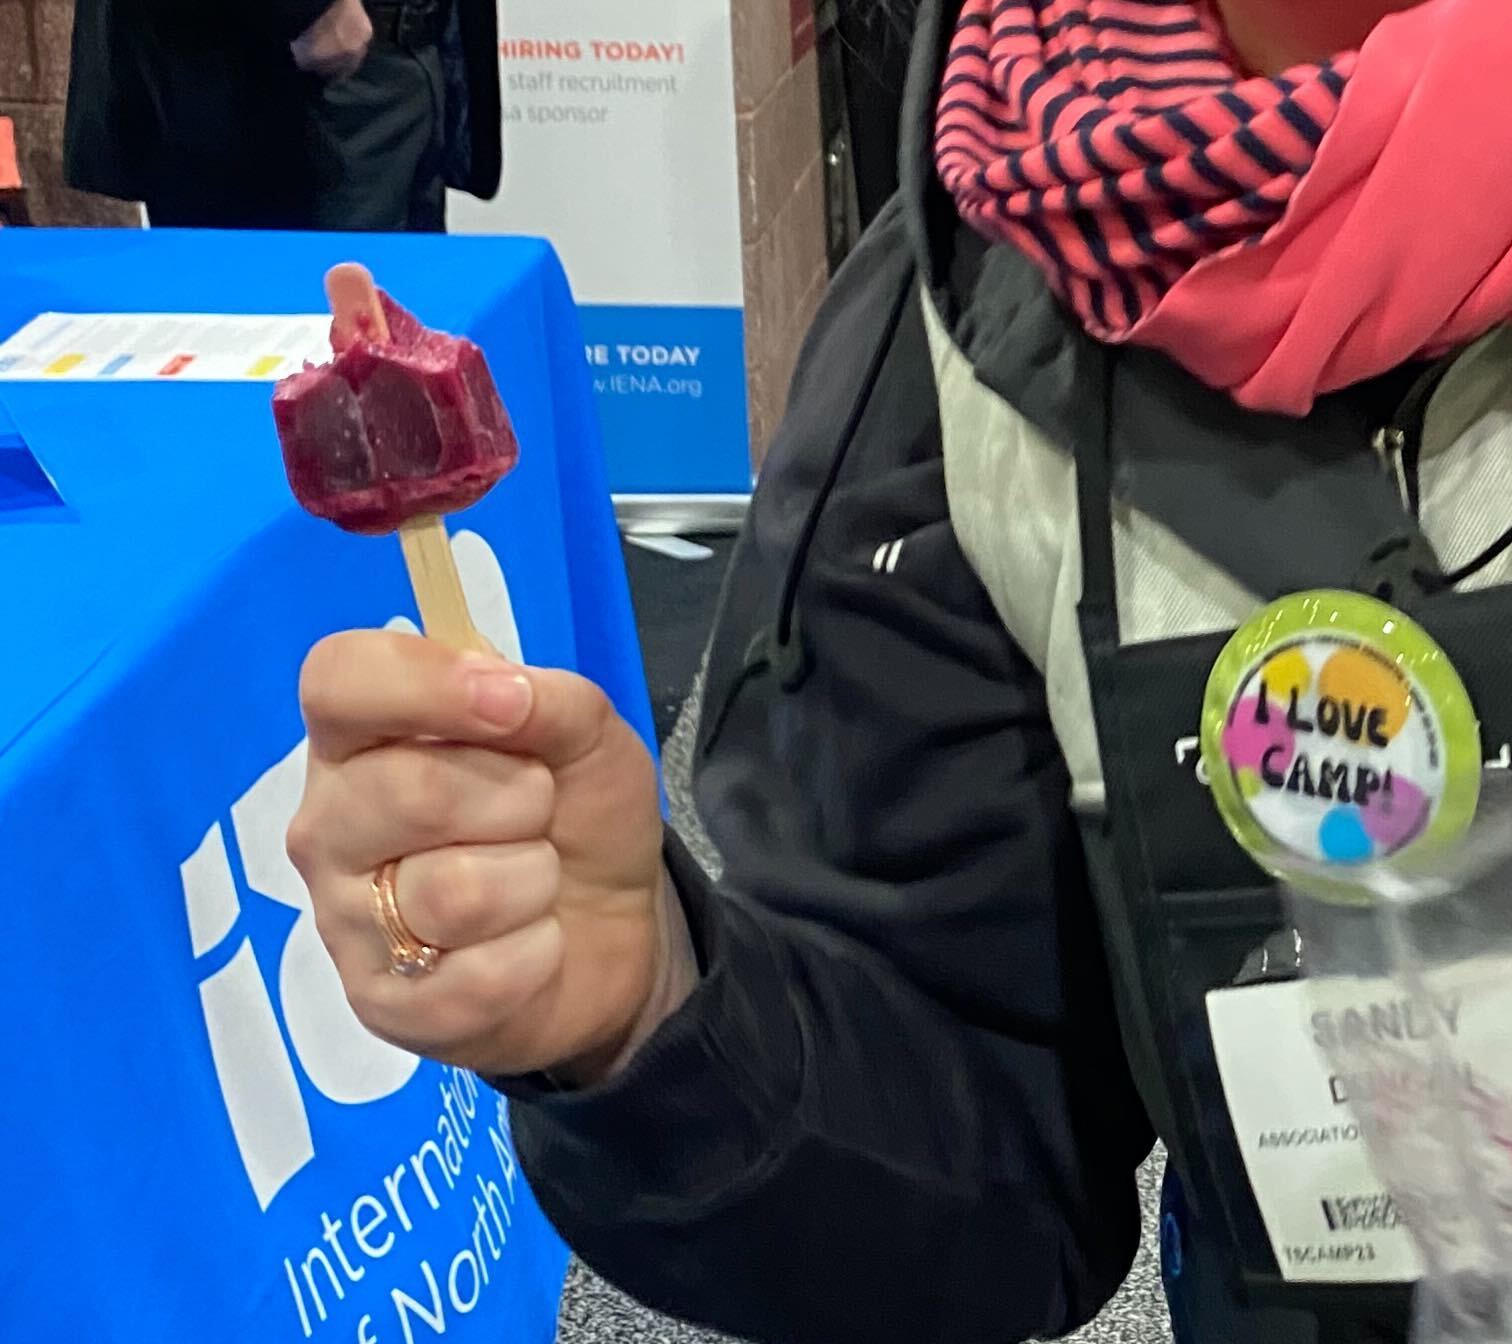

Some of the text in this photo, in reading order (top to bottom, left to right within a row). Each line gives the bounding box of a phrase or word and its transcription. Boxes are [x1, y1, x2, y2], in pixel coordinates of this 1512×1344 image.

[590, 41, 684, 64] TODAY!
[508, 72, 678, 96] staff recruitment
[527, 104, 609, 124] sponsor
[616, 344, 701, 366] TODAY
[1256, 679, 1270, 724] I
[1287, 684, 1390, 748] LOVE
[1260, 744, 1395, 810] CAMP!
